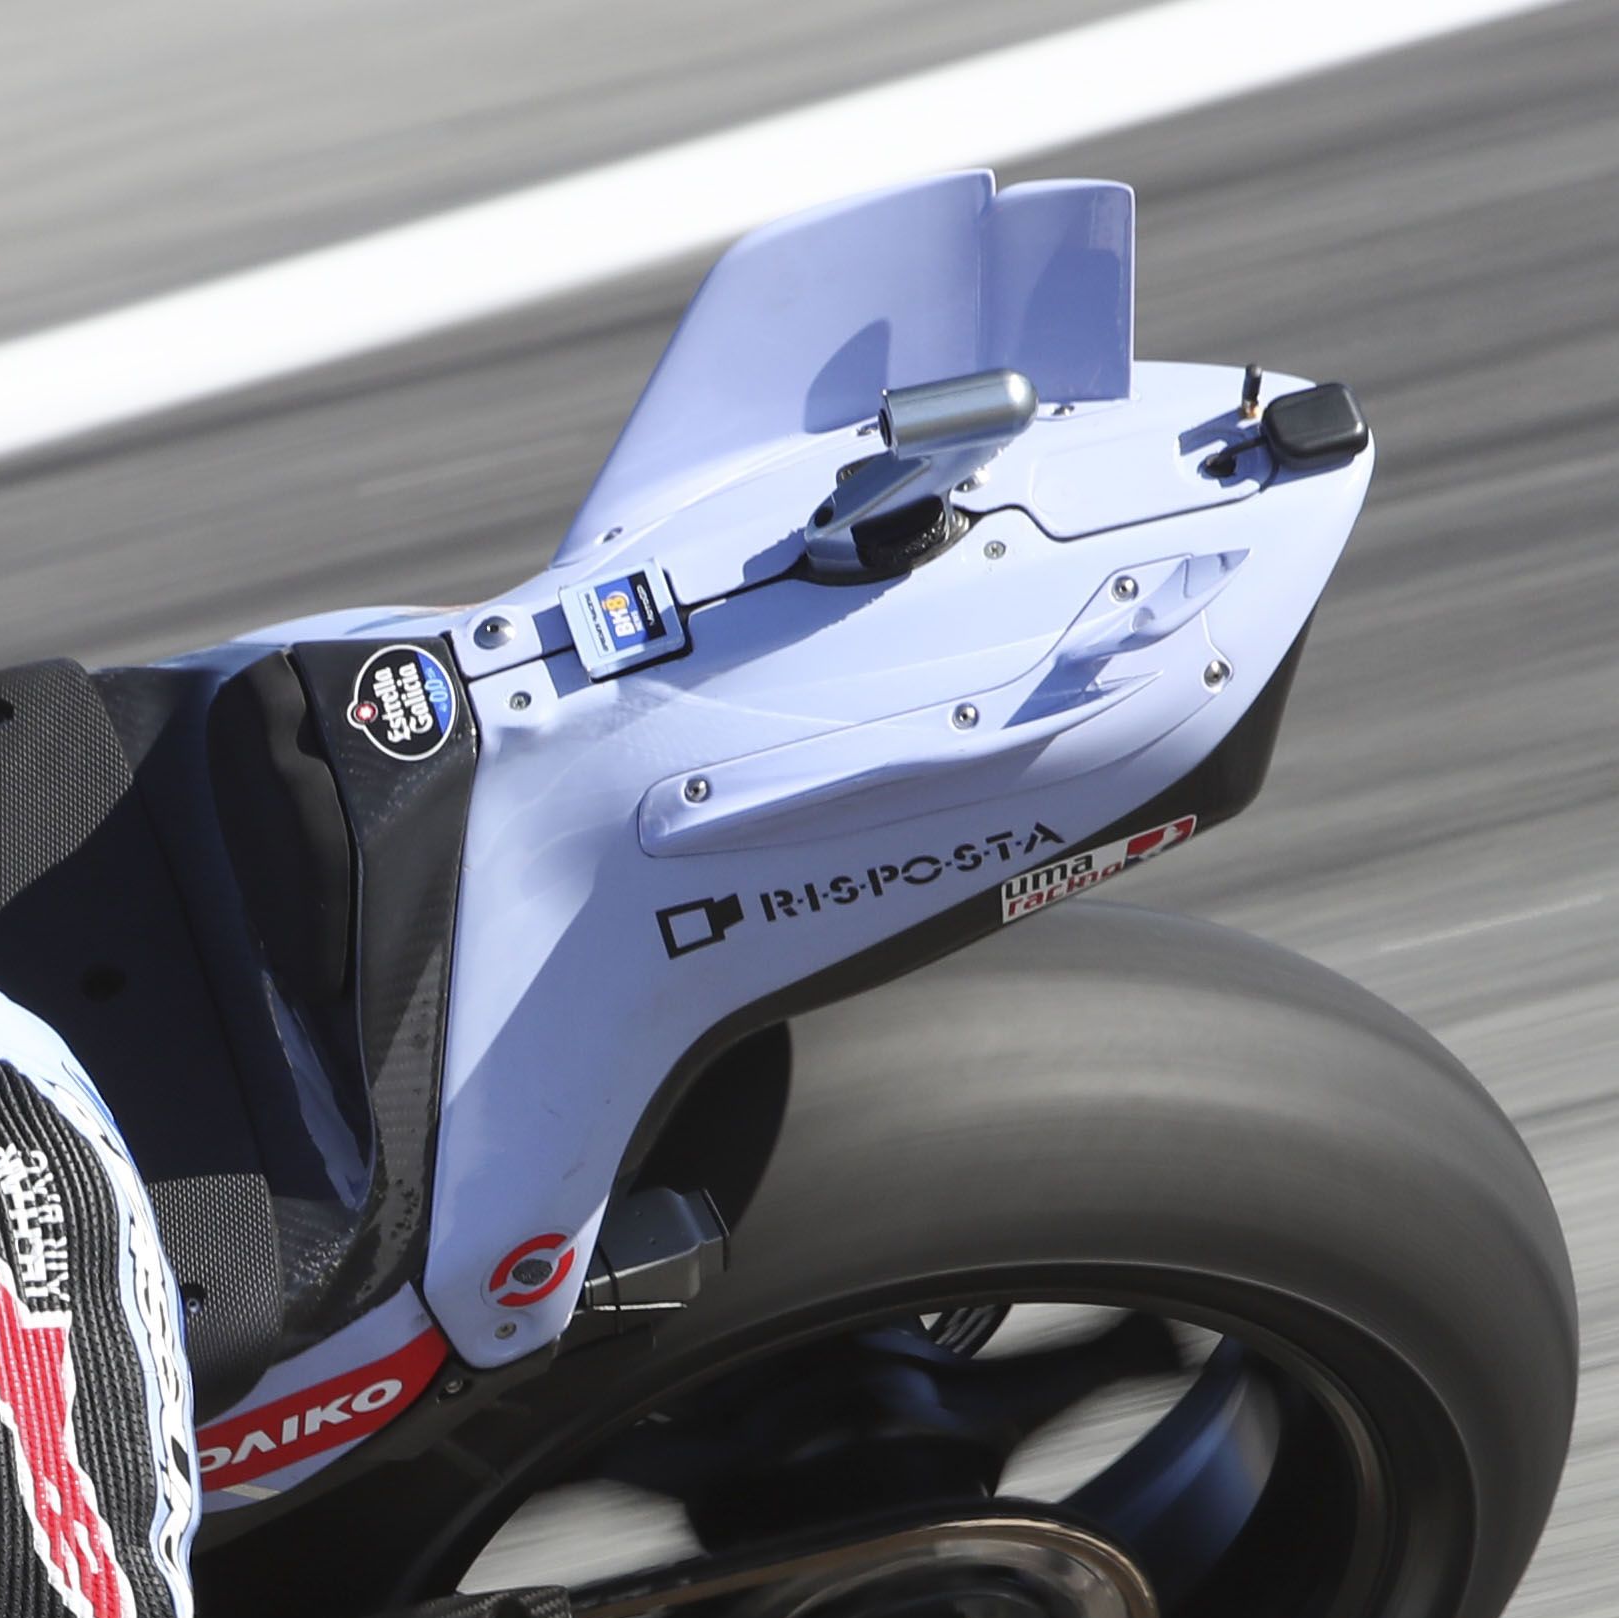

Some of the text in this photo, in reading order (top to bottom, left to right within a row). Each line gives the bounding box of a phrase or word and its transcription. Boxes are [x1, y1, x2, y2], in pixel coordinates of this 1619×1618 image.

[373, 667, 414, 743] Estrella
[397, 663, 434, 734] Galicia
[1005, 854, 1094, 901] uma
